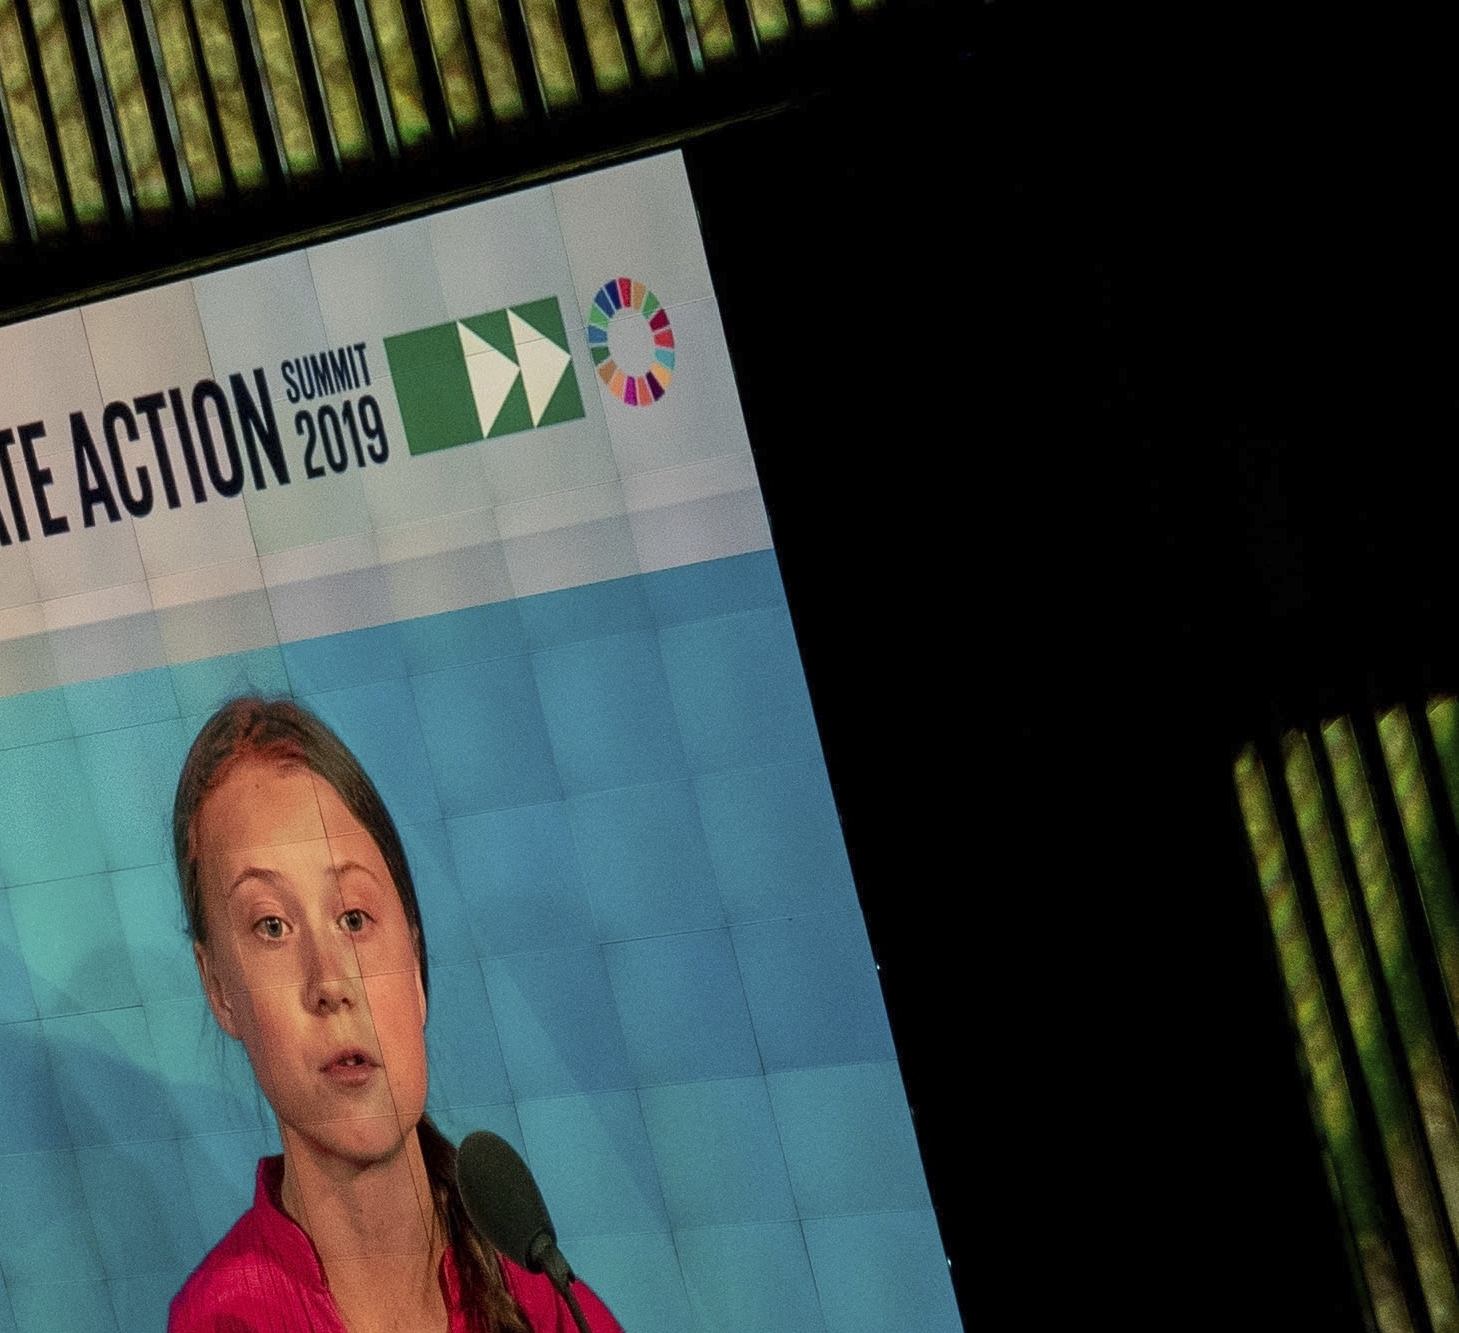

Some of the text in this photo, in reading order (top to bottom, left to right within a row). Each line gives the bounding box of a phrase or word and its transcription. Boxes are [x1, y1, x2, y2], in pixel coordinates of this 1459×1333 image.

[280, 342, 371, 404] SUMMIT
[69, 367, 291, 528] ACTION
[294, 395, 389, 480] 2019
